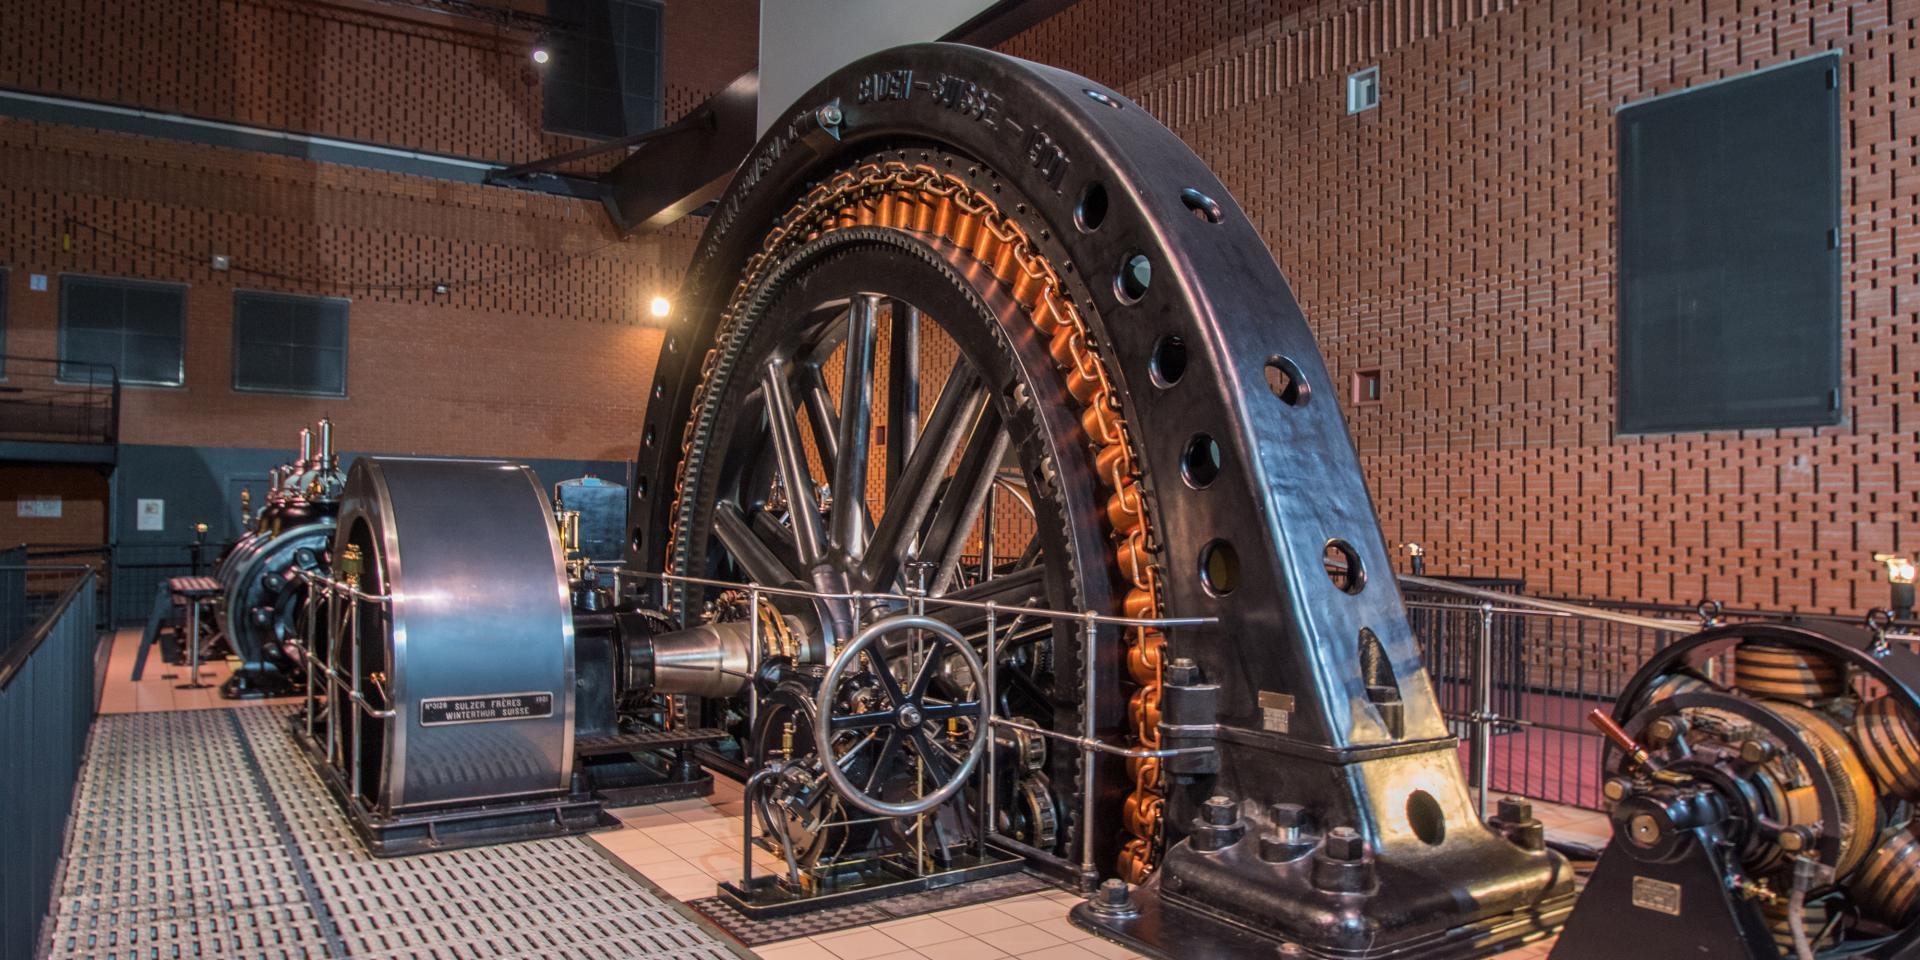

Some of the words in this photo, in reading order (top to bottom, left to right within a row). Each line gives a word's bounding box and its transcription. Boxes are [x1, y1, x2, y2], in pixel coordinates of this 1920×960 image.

[454, 700, 486, 710] SULZER
[445, 709, 497, 721] WINTERTHUR
[502, 706, 530, 716] SUISSE
